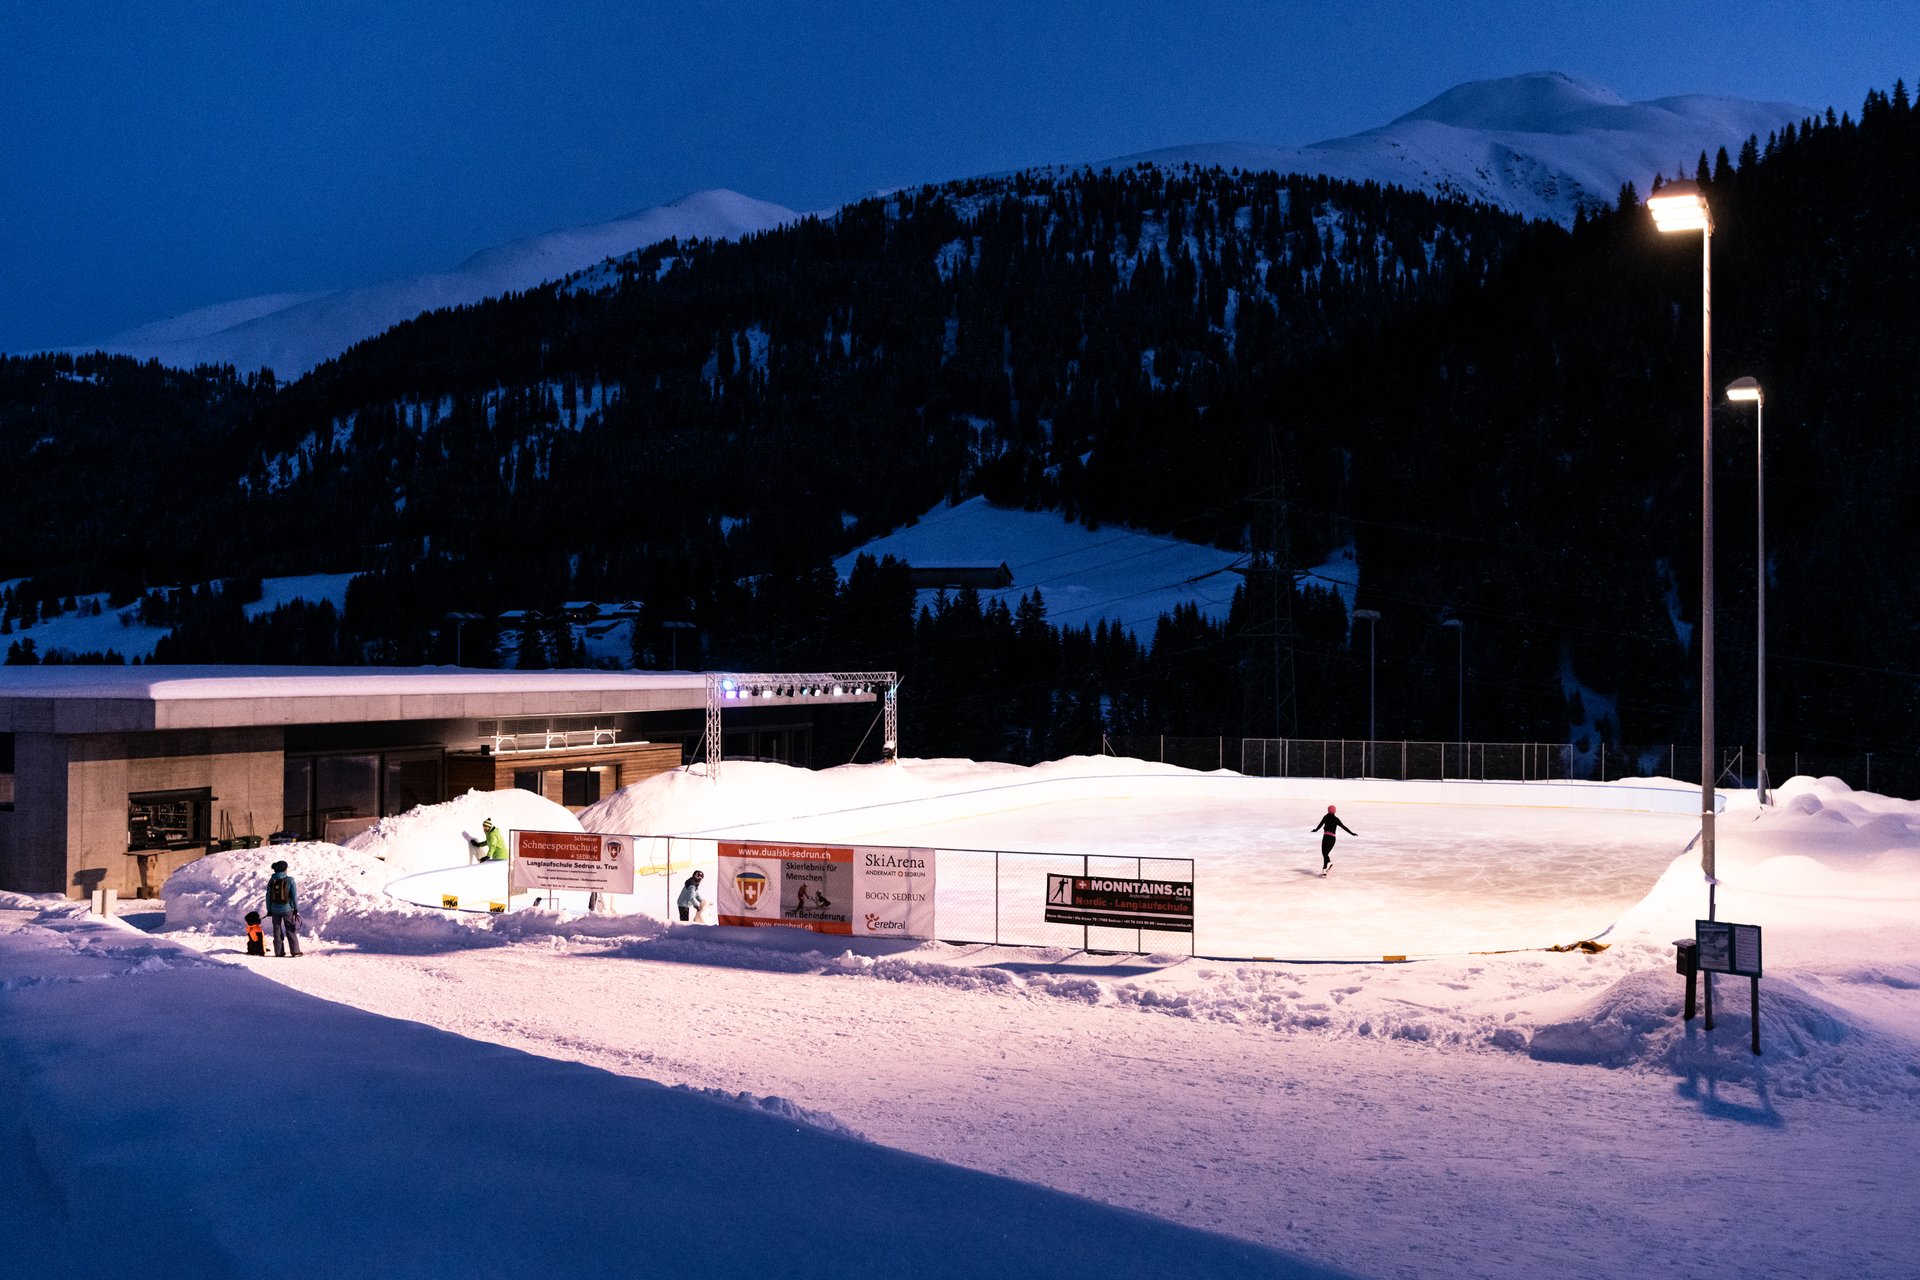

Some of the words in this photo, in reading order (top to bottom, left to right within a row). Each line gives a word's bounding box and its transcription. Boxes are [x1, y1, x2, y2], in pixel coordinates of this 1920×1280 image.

[522, 840, 598, 853] Schneesportschule
[738, 846, 831, 860] www.dualski-sedrun.ch
[527, 860, 573, 869] Langlaufschule
[574, 862, 595, 870] Sedrun
[604, 863, 618, 871] Trun
[786, 862, 826, 872] Skierlebnis
[826, 864, 838, 873] für
[865, 853, 925, 869] SkiArena
[786, 872, 823, 882] Menschen
[1091, 880, 1191, 897] MONNTAINS.ch
[865, 892, 889, 900] BOGN
[891, 893, 926, 902] SEDRUN
[1075, 897, 1107, 907] Nordic
[1115, 900, 1189, 912] Langlaufschule
[785, 910, 798, 918] mit
[799, 910, 846, 922] Behinderung
[866, 918, 906, 931] Cerebral
